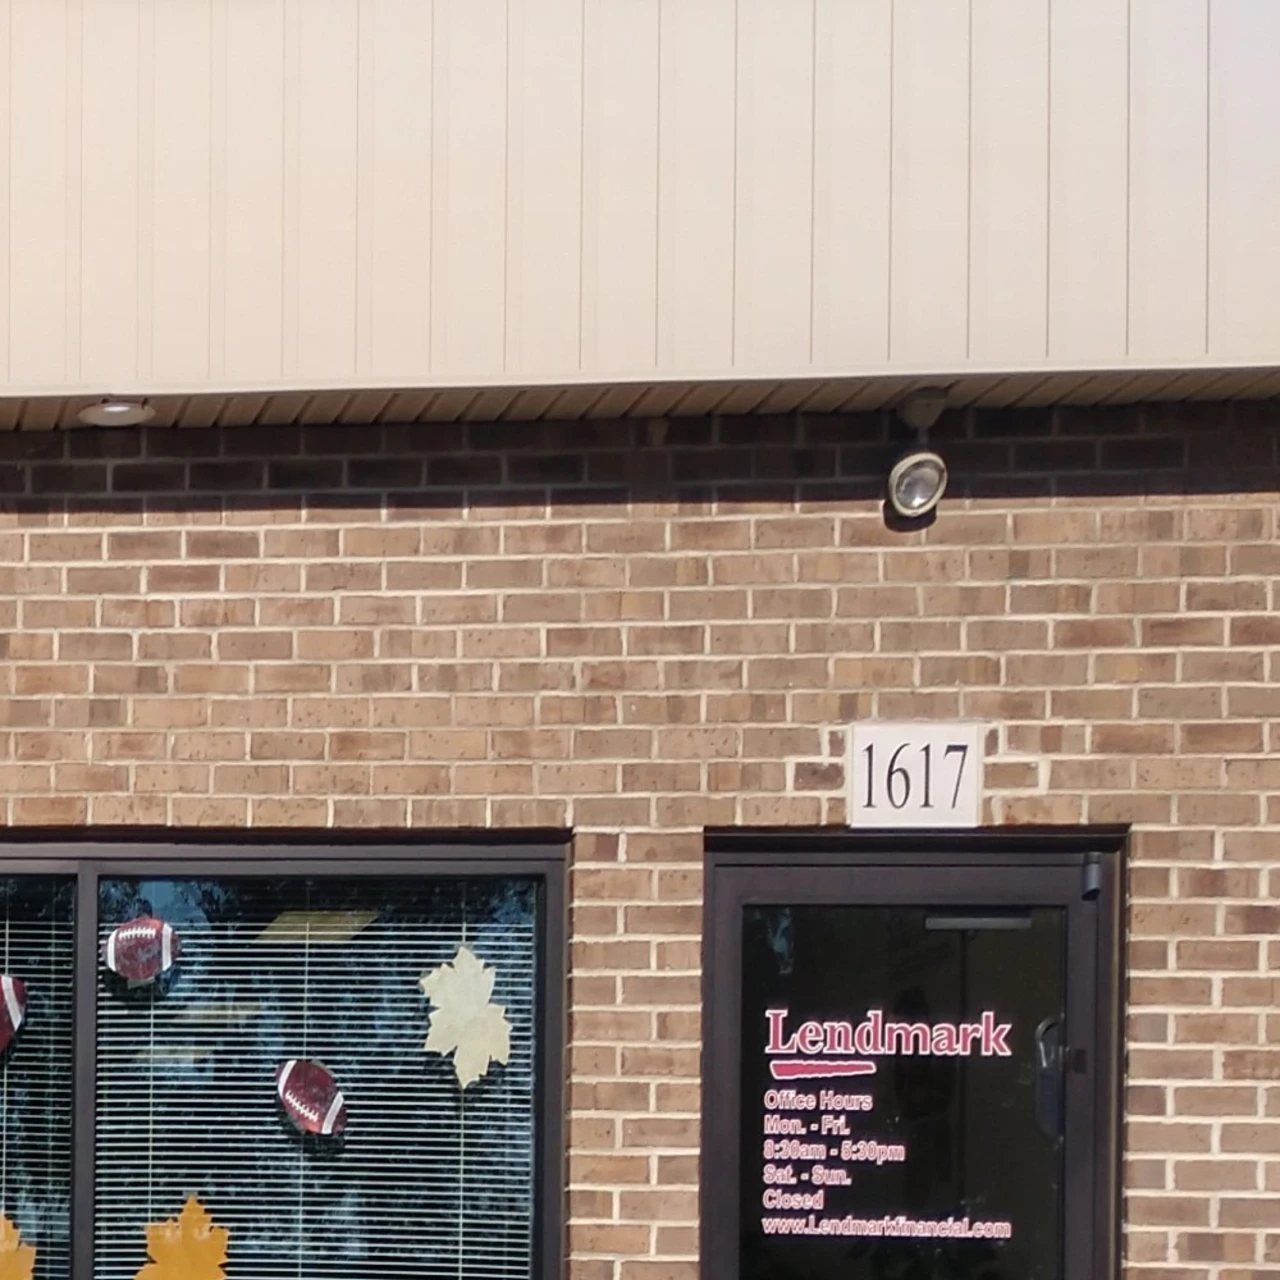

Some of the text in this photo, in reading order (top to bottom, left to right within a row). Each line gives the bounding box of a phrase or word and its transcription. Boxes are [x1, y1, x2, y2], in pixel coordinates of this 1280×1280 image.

[862, 743, 968, 809] 1617
[764, 1008, 1012, 1057] Lendmark
[764, 1089, 873, 1111] Office Hours
[764, 1114, 807, 1135] Mon.
[821, 1115, 850, 1135] Fri.
[763, 1139, 827, 1160] 8:30am
[841, 1140, 906, 1165] 5:30pm
[763, 1163, 797, 1184] Sat.
[811, 1165, 852, 1185] Sun.
[762, 1188, 824, 1210] Closed
